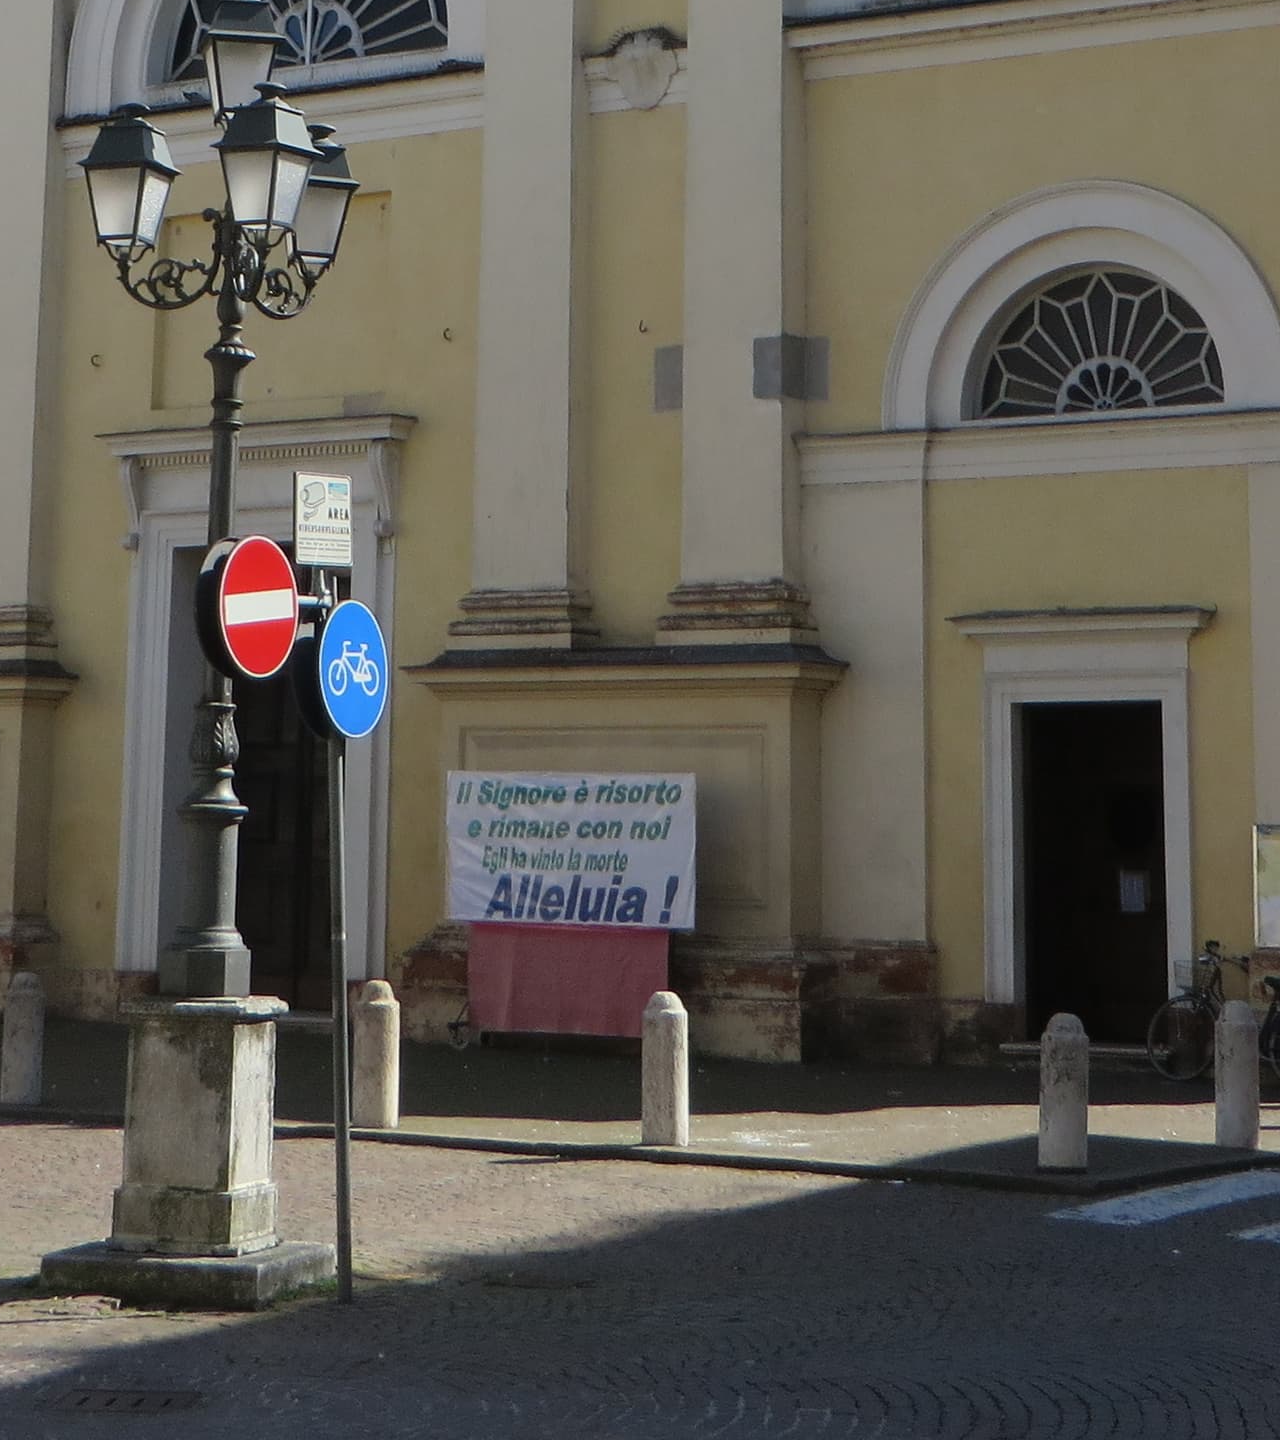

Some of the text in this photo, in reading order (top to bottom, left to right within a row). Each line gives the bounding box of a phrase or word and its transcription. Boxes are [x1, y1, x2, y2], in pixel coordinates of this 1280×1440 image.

[328, 507, 349, 520] AREA
[477, 780, 567, 810] Signore
[574, 779, 589, 804] è
[595, 779, 682, 805] risorto
[467, 814, 672, 841] e rimane con noi
[482, 845, 629, 874] Egli ha vinto la morte
[485, 874, 648, 923] Alleluia
